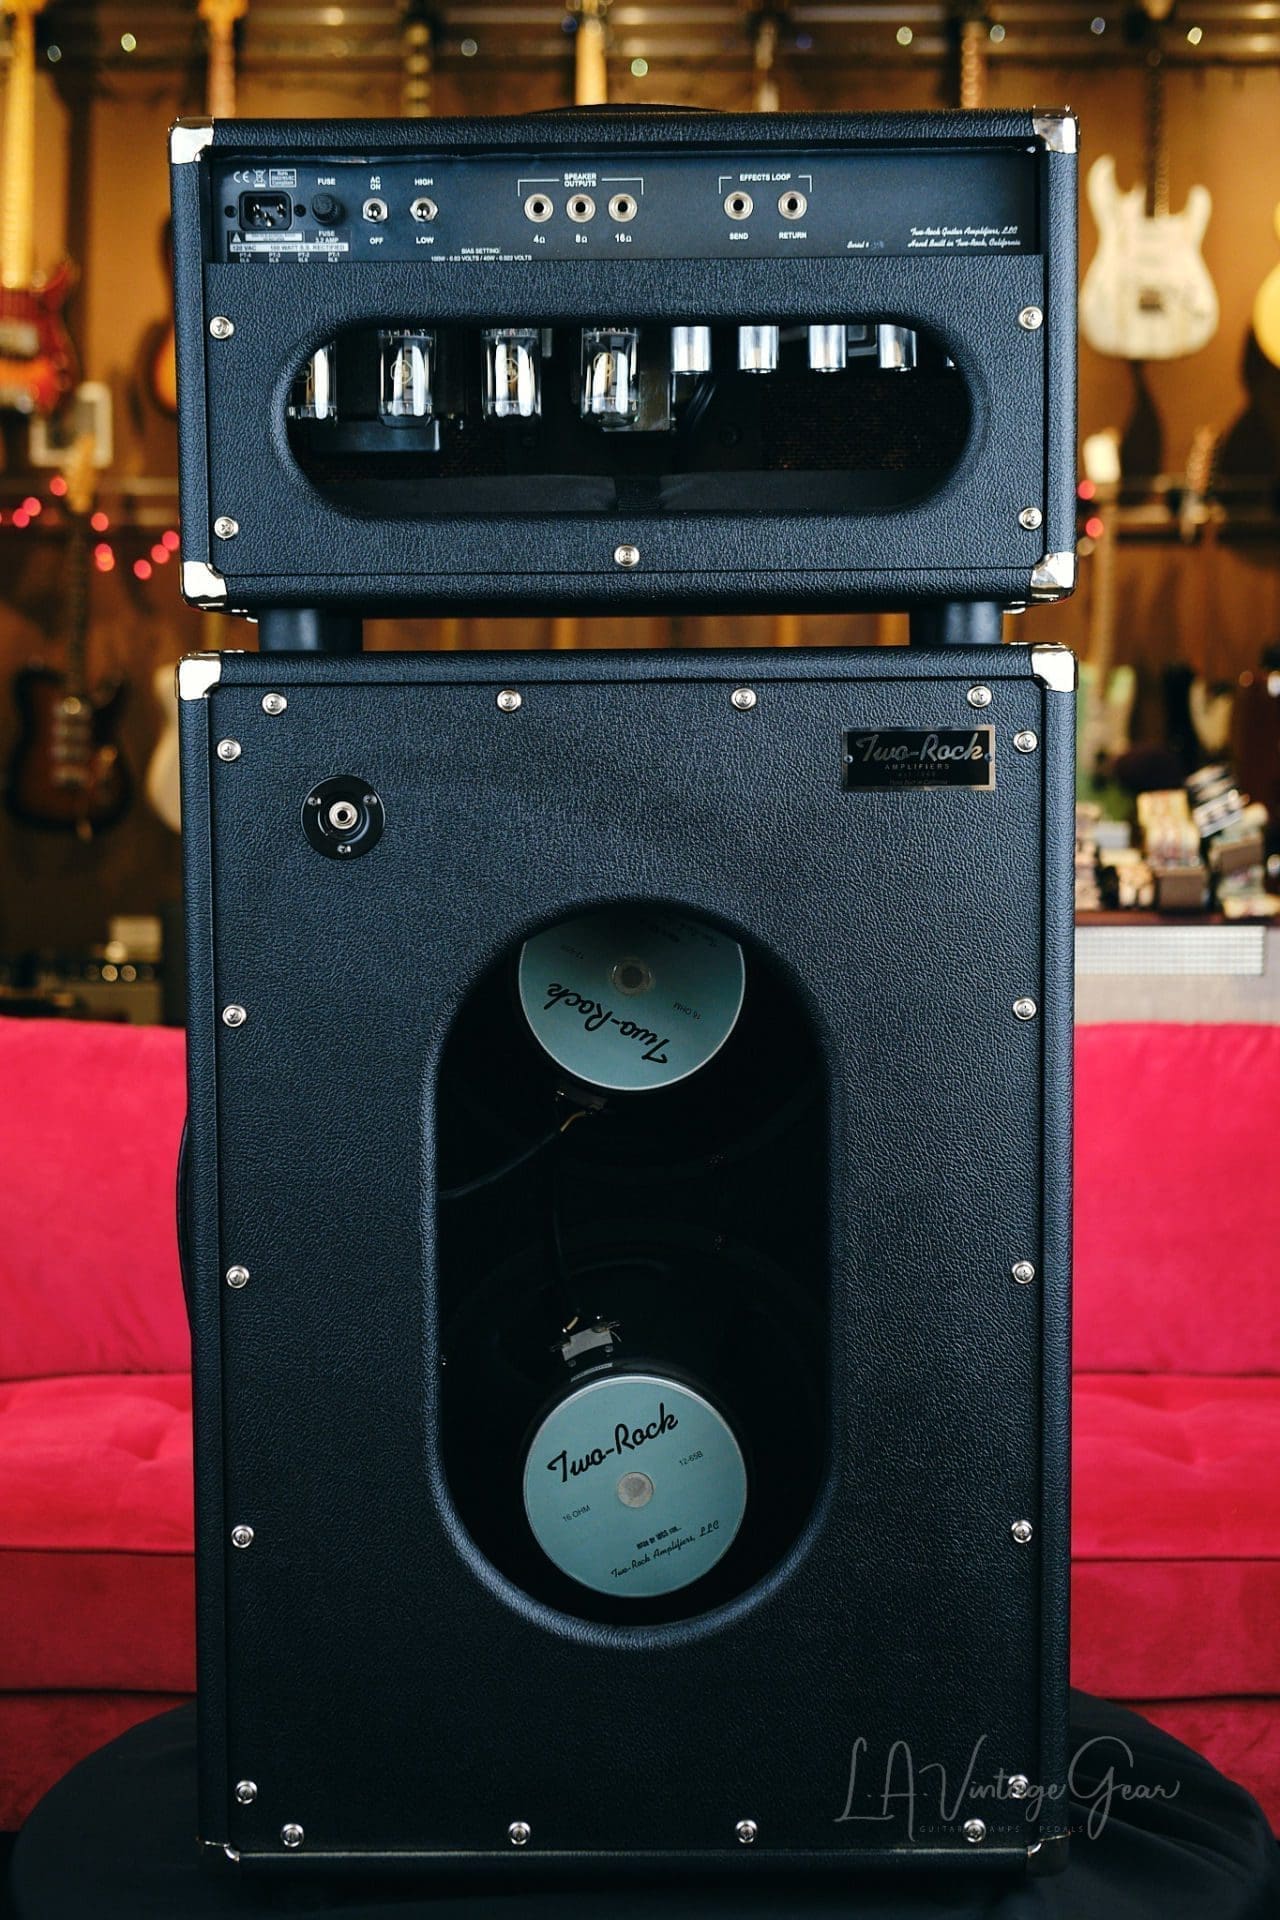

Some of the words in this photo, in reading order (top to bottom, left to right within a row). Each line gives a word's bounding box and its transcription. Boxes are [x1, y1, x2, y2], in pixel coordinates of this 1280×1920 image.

[317, 178, 336, 186] FUSE
[370, 176, 381, 184] AC
[414, 178, 434, 186] HIGH
[739, 174, 770, 182] EFFECTS
[771, 173, 791, 181] LOOP
[564, 180, 597, 188] OUTPUTS
[729, 232, 749, 240] SEND
[910, 226, 940, 236] Two-Rock
[941, 226, 963, 237] Guitar
[369, 236, 384, 245] OFF
[415, 236, 435, 244] LOW
[907, 239, 928, 248] Hand
[928, 239, 946, 247] Built
[988, 238, 1021, 248] California
[855, 732, 984, 762] Two-Rock
[544, 982, 669, 1064] Two-Rock
[547, 1402, 678, 1482] Two-Rock
[562, 1512, 573, 1523] 16
[572, 1504, 591, 1519] OHM
[610, 1553, 651, 1578] Two-Rock
[653, 1535, 696, 1559] Amplifiers,
[699, 1520, 720, 1537] LLC
